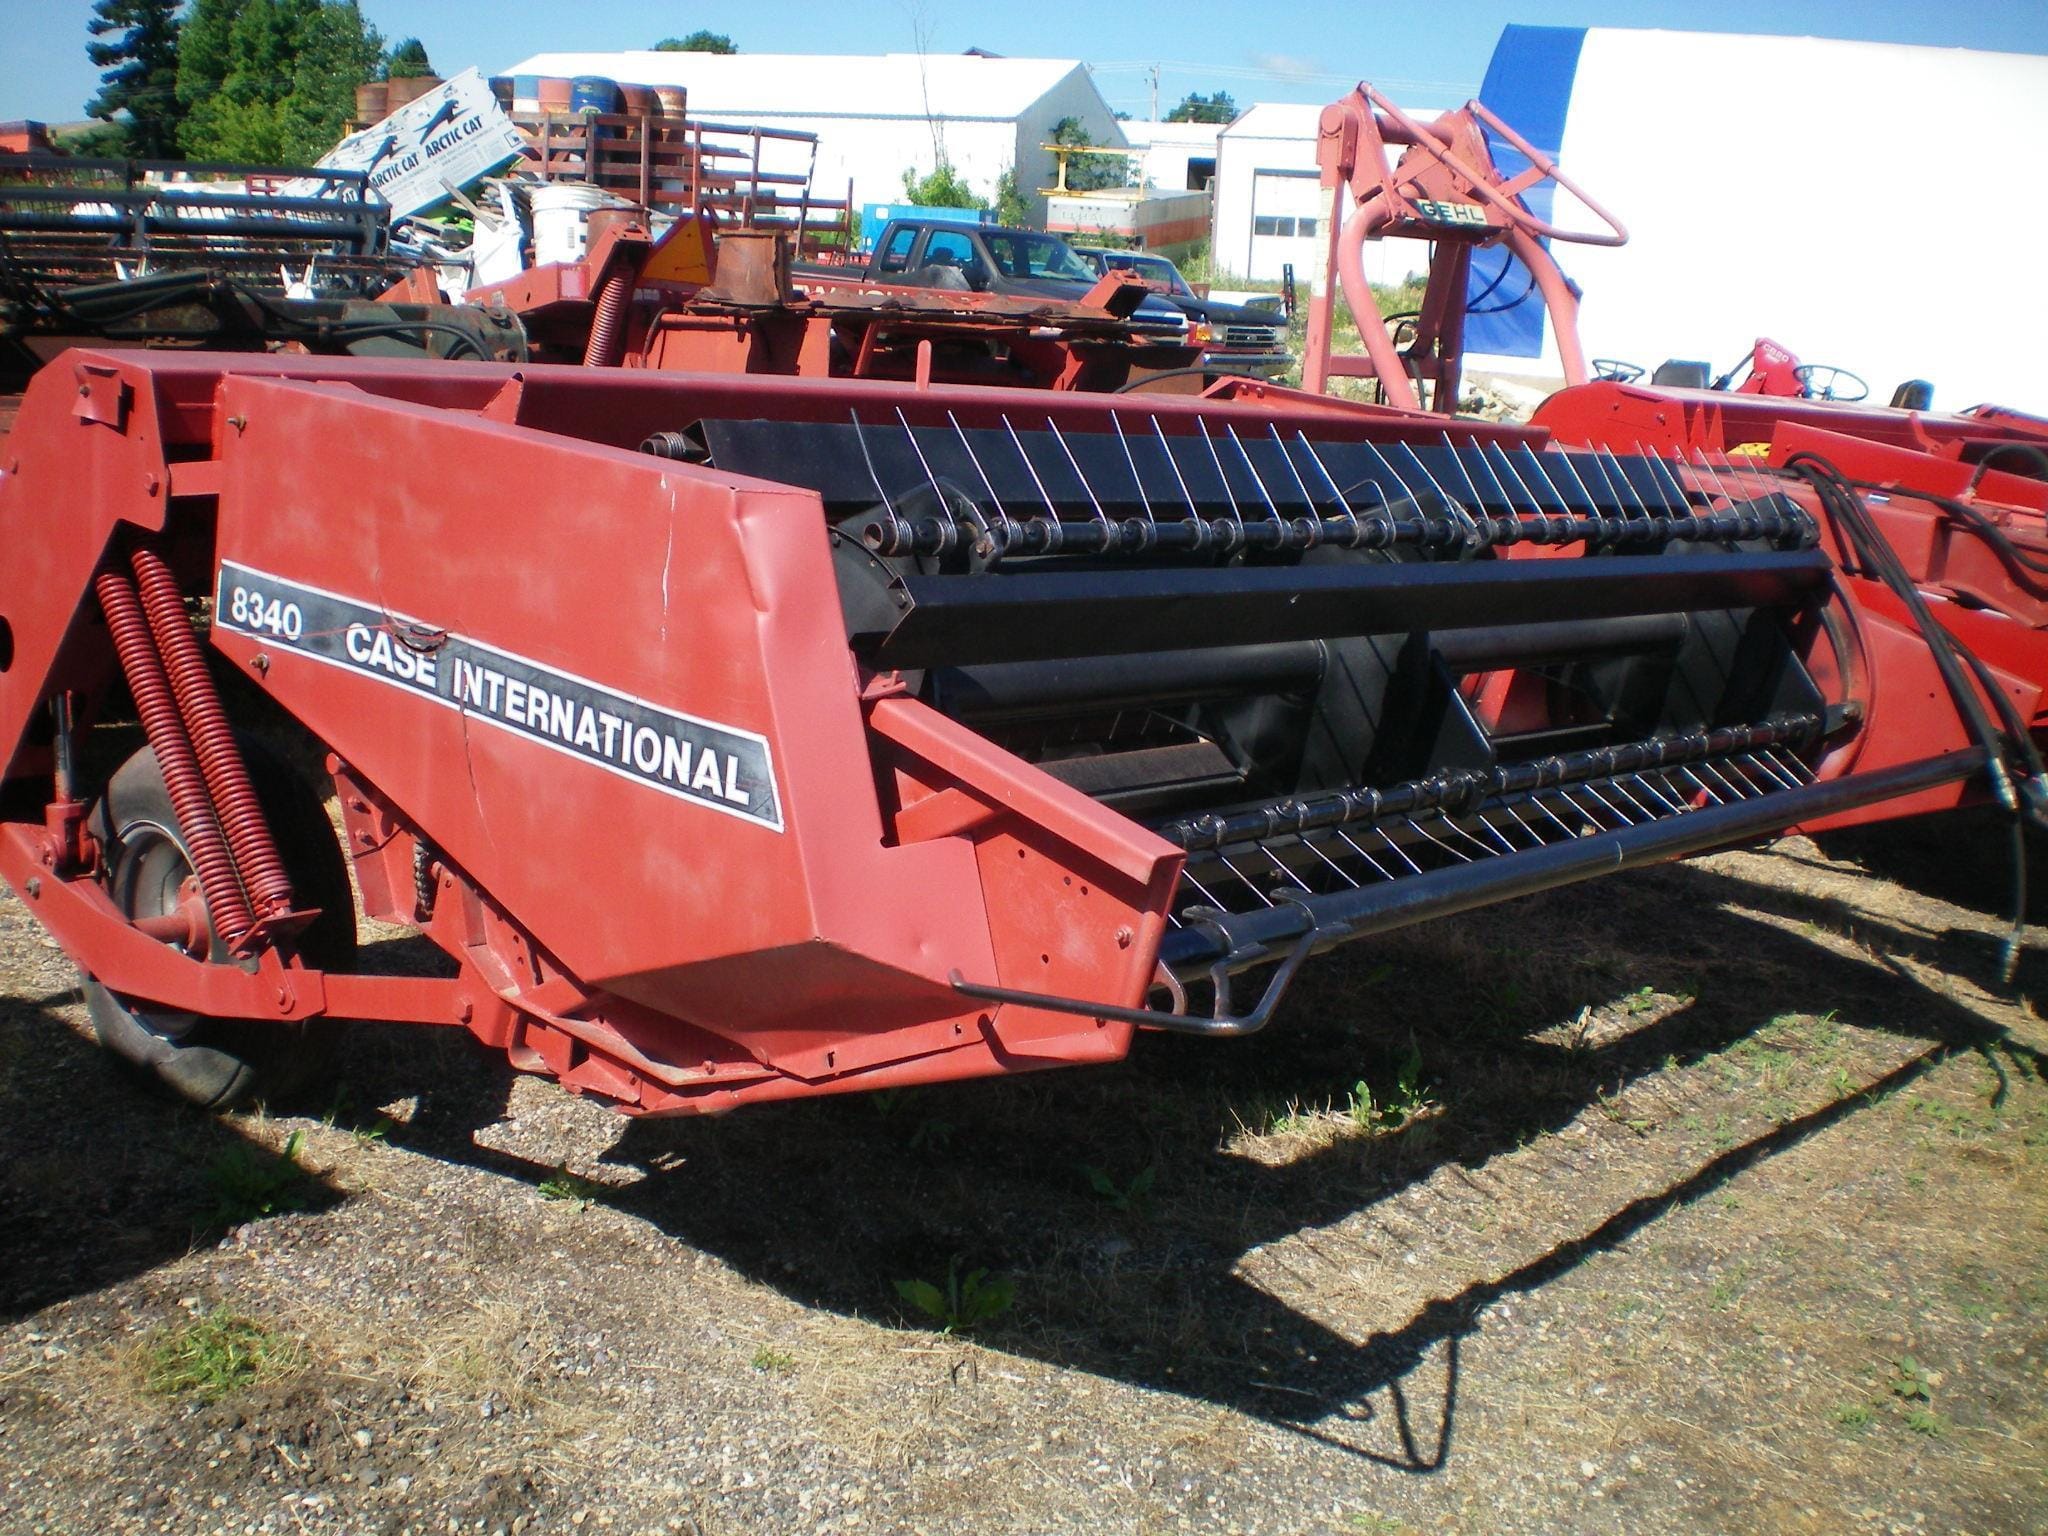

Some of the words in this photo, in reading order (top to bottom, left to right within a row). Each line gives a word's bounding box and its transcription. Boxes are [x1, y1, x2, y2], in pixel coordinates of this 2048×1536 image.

[425, 127, 463, 158] ARCTIC
[463, 115, 483, 136] CAT
[371, 163, 402, 189] ARCTIC
[402, 152, 421, 172] CAT
[1422, 202, 1485, 222] GEHL
[231, 585, 303, 641] 8340
[345, 621, 437, 688] CASE
[453, 656, 750, 807] INTERNATIONAL
